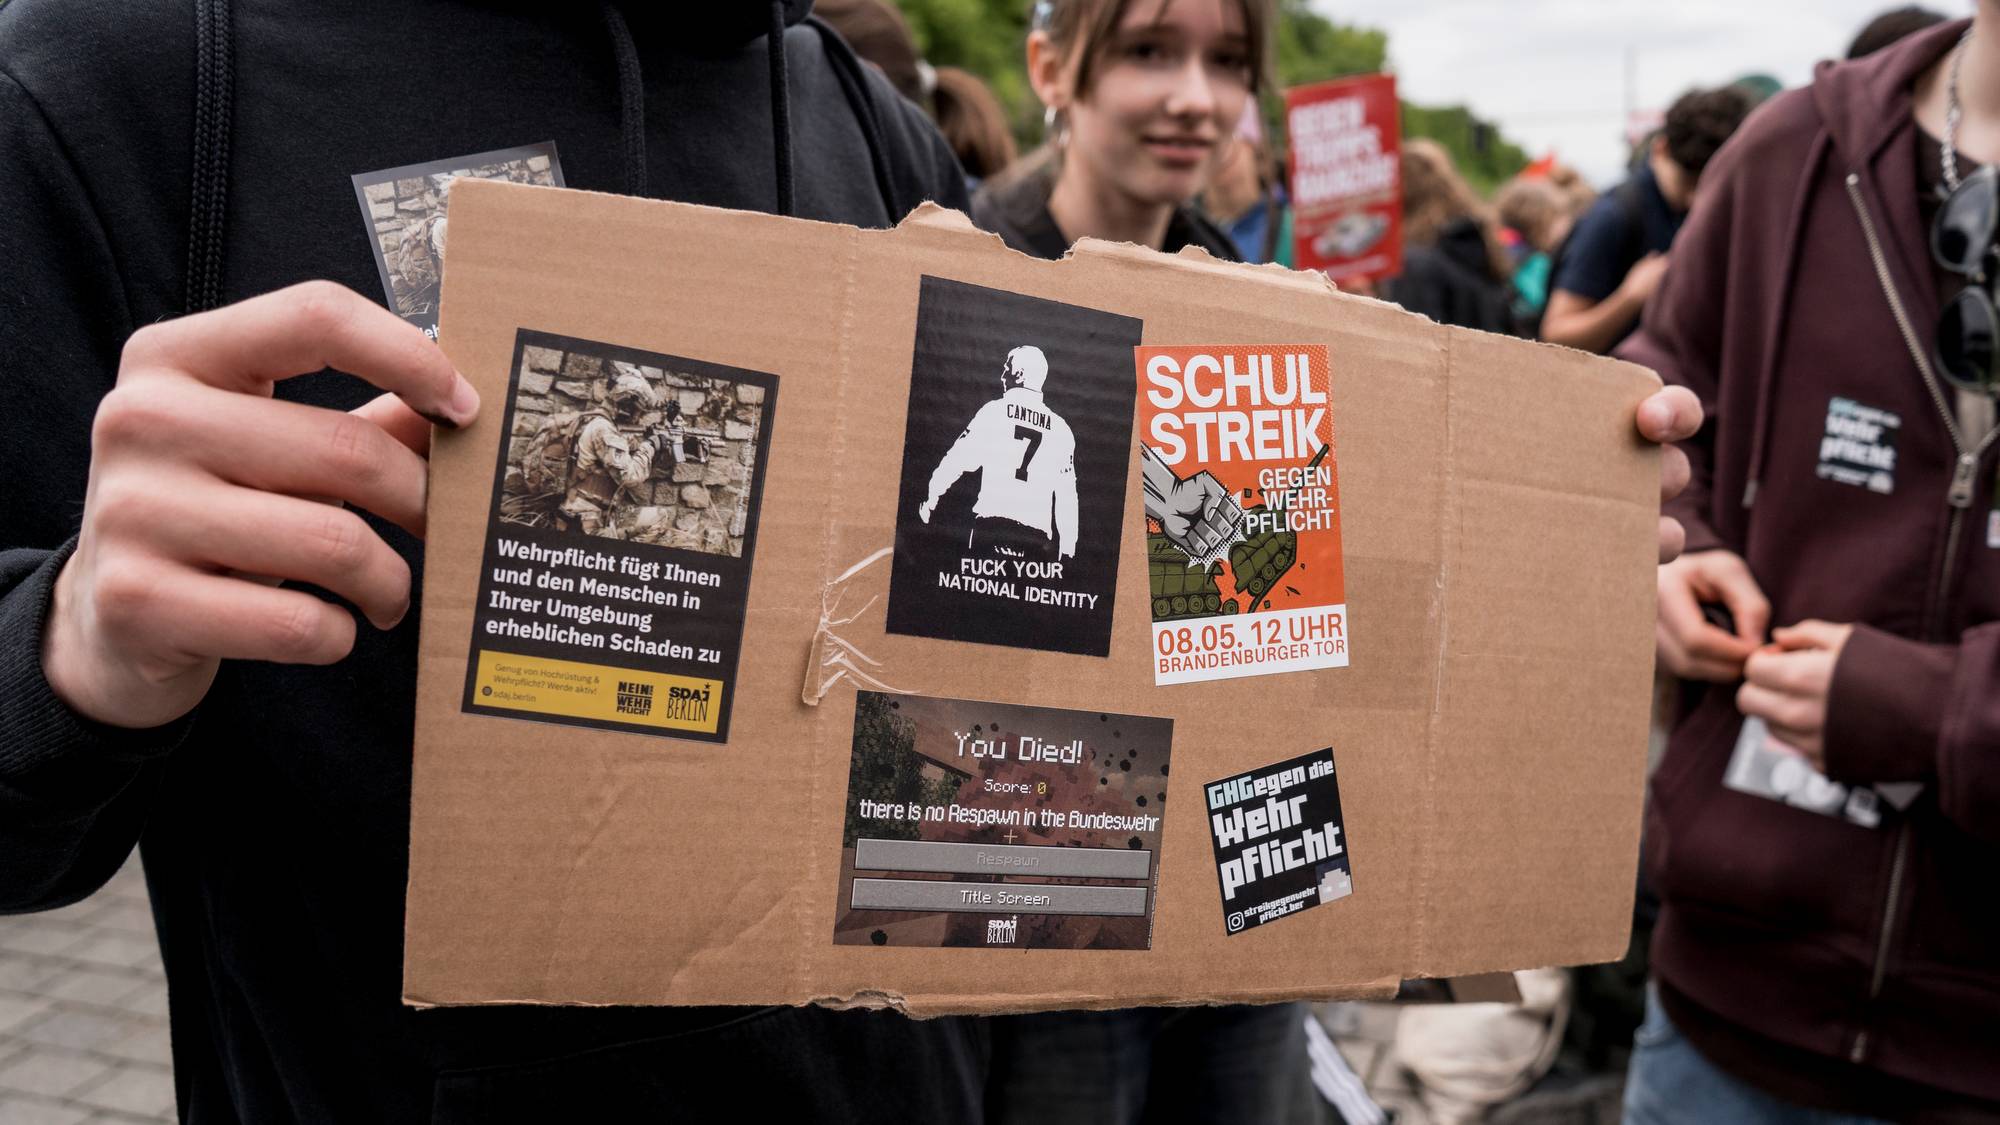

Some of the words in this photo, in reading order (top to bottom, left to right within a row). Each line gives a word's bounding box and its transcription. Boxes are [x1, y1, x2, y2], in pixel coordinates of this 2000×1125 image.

[1146, 354, 1327, 409] SCHUL
[1007, 404, 1051, 430] CANTONA
[1150, 408, 1328, 465] STREIK
[1014, 425, 1042, 482] 7
[1258, 466, 1331, 488] GEGEN
[1263, 488, 1332, 510] WEHR-
[1246, 510, 1334, 534] PFLICHT
[497, 538, 616, 572] Wehrpflicht
[620, 556, 660, 581] fügt
[664, 563, 721, 587] Ihnen
[961, 558, 1006, 576] FUCK
[1013, 561, 1064, 579] YOUR
[493, 568, 532, 586] und
[537, 571, 574, 592] den
[579, 576, 677, 607] Menschen
[683, 591, 701, 610] in
[938, 572, 1020, 599] NATIONAL
[1025, 586, 1098, 610] IDENTITY
[489, 590, 541, 614] Ihrer
[546, 598, 653, 632] Umgebung
[486, 618, 604, 648] erheblichen
[610, 633, 693, 660] Schaden
[698, 649, 721, 663] zu
[1158, 624, 1242, 656] 08.05.
[1251, 619, 1282, 645] 12
[1289, 614, 1342, 642] UHR
[1160, 644, 1310, 674] BRANDENBURGER
[1314, 640, 1344, 656] TOR
[494, 674, 545, 689] Wehrpflicht?
[547, 682, 573, 692] Werde
[575, 686, 598, 695] aktiv!
[495, 663, 522, 676] Genug
[523, 668, 538, 676] von
[540, 669, 592, 684] Hochrüstung
[594, 676, 600, 684] &
[494, 690, 537, 702] sdaj.berlin
[617, 695, 652, 709] WEHR
[616, 705, 651, 716] PFLICHT
[667, 697, 709, 722] BERLIN
[954, 732, 1006, 758] You
[1018, 736, 1082, 764] Died!
[1308, 760, 1334, 780] die
[984, 779, 1032, 794] Score:
[1037, 782, 1047, 794] 0
[860, 799, 904, 820] there
[908, 802, 921, 820] is
[925, 805, 944, 822] no
[950, 804, 1020, 826] Respawn
[1023, 808, 1036, 826] in
[1040, 809, 1065, 828] the
[1069, 810, 1159, 832] Bundeswehr
[1212, 794, 1308, 848] Wehr
[977, 852, 1039, 868] Respawn
[1220, 822, 1342, 901] pflicht
[960, 890, 992, 904] Title
[997, 891, 1050, 906] Screen
[1244, 887, 1316, 917] streikgegenwehr
[1260, 900, 1304, 924] pflicht.ber
[987, 927, 1016, 943] BERLIN
